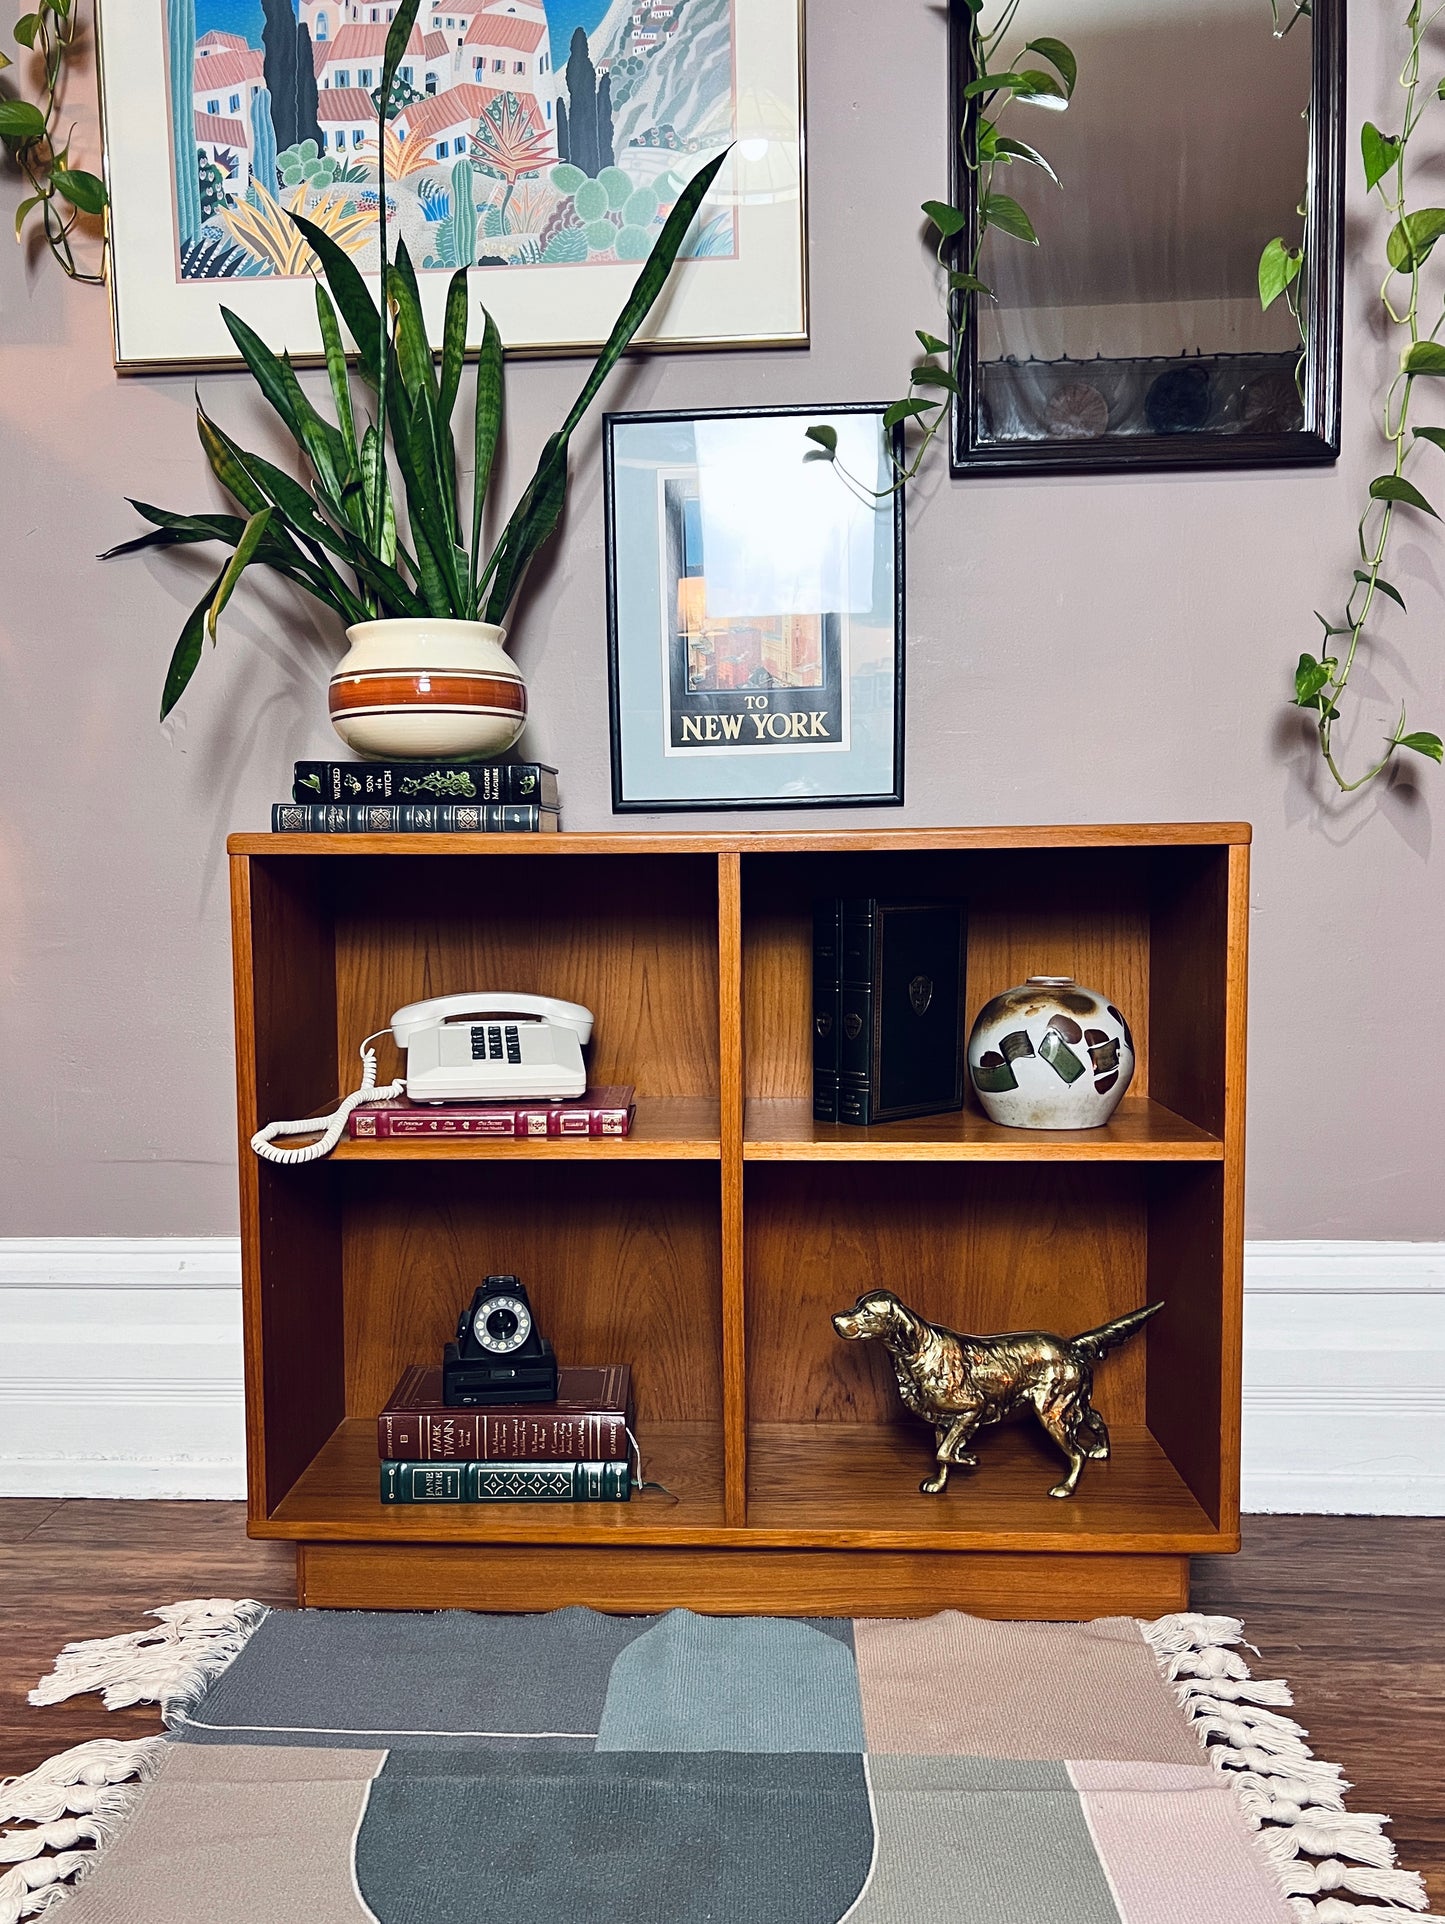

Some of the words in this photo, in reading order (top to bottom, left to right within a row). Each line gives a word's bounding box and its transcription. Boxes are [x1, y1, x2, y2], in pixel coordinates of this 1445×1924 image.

[744, 695, 769, 710] TO
[681, 714, 744, 741] NEW
[750, 711, 830, 739] YORK
[333, 768, 341, 799] WICKED
[366, 775, 374, 792] SON
[384, 770, 392, 797] WITCH
[433, 1424, 441, 1452] MARK
[444, 1419, 454, 1456] TWAIN
[426, 1472, 435, 1496] JANE
[435, 1472, 443, 1496] EYRE
